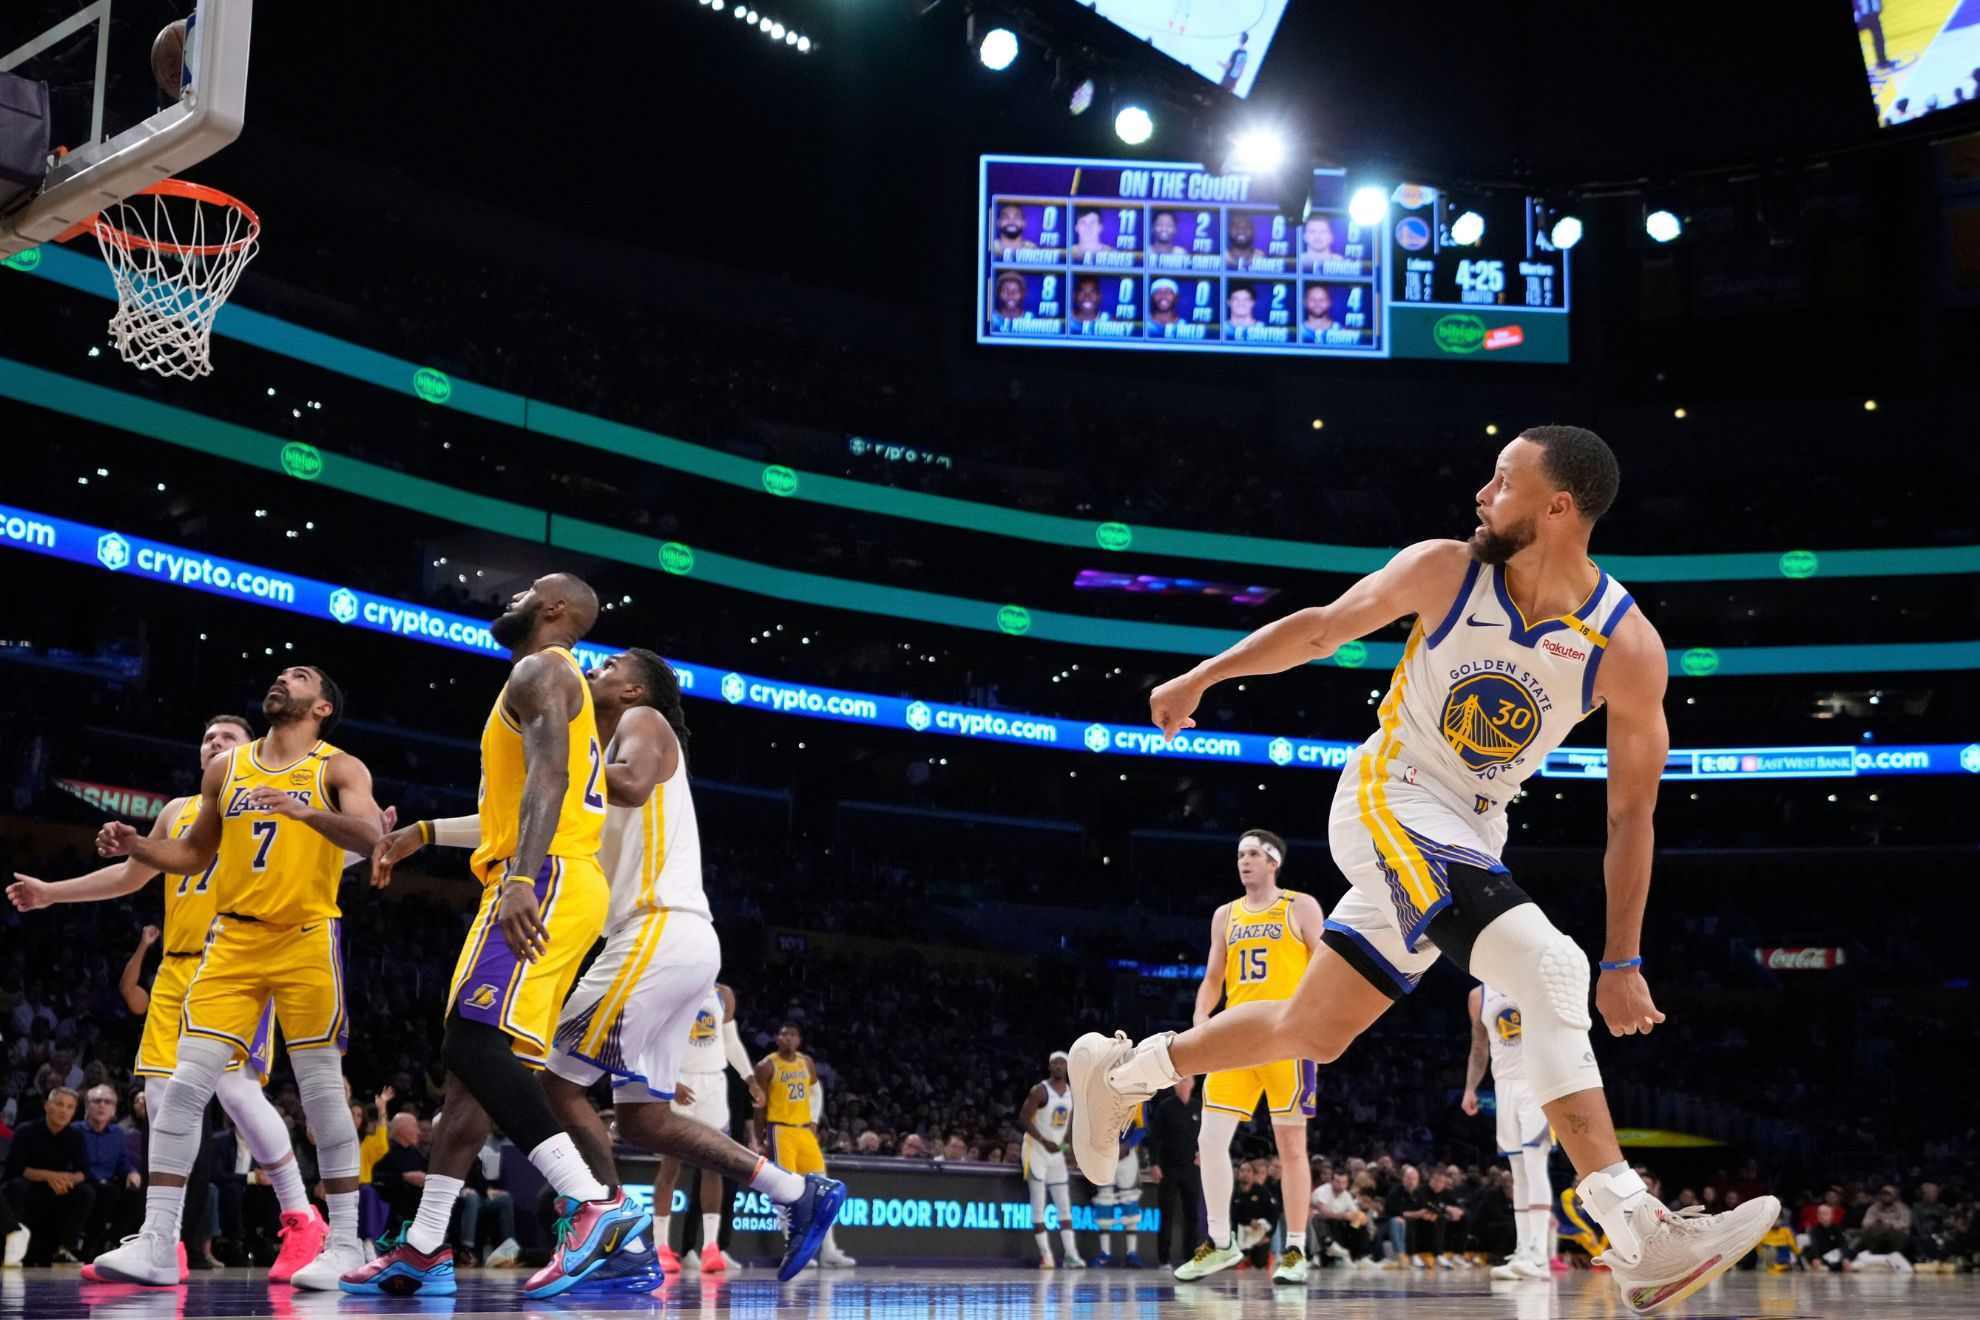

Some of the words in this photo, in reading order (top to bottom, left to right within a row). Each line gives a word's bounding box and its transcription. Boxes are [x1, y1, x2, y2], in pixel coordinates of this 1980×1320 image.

[1119, 170, 1149, 198] ON
[1151, 171, 1186, 199] THE
[1187, 172, 1251, 201] COURT
[1119, 209, 1136, 234] 11
[1196, 212, 1210, 237] 2
[1042, 275, 1056, 300] 8
[1456, 259, 1504, 292] 4:25
[1119, 278, 1133, 303] 0
[1196, 281, 1210, 306] 0
[1272, 284, 1286, 309] 2
[1347, 287, 1361, 312] 4
[136, 547, 295, 604] crypto.com
[1542, 639, 1585, 662] Rakuten
[1449, 659, 1517, 680] GOLDEN
[1520, 671, 1553, 713] STATE
[749, 682, 877, 719] crypto.com
[1492, 698, 1532, 729] 30
[935, 708, 1057, 742] crypto.com
[251, 820, 277, 870] 7
[1228, 923, 1283, 946] LAKERS
[1239, 947, 1268, 982] 15
[787, 1083, 806, 1100] 28
[872, 1198, 932, 1227] DOOR
[934, 1200, 961, 1228] TO
[963, 1201, 1000, 1229] ALL
